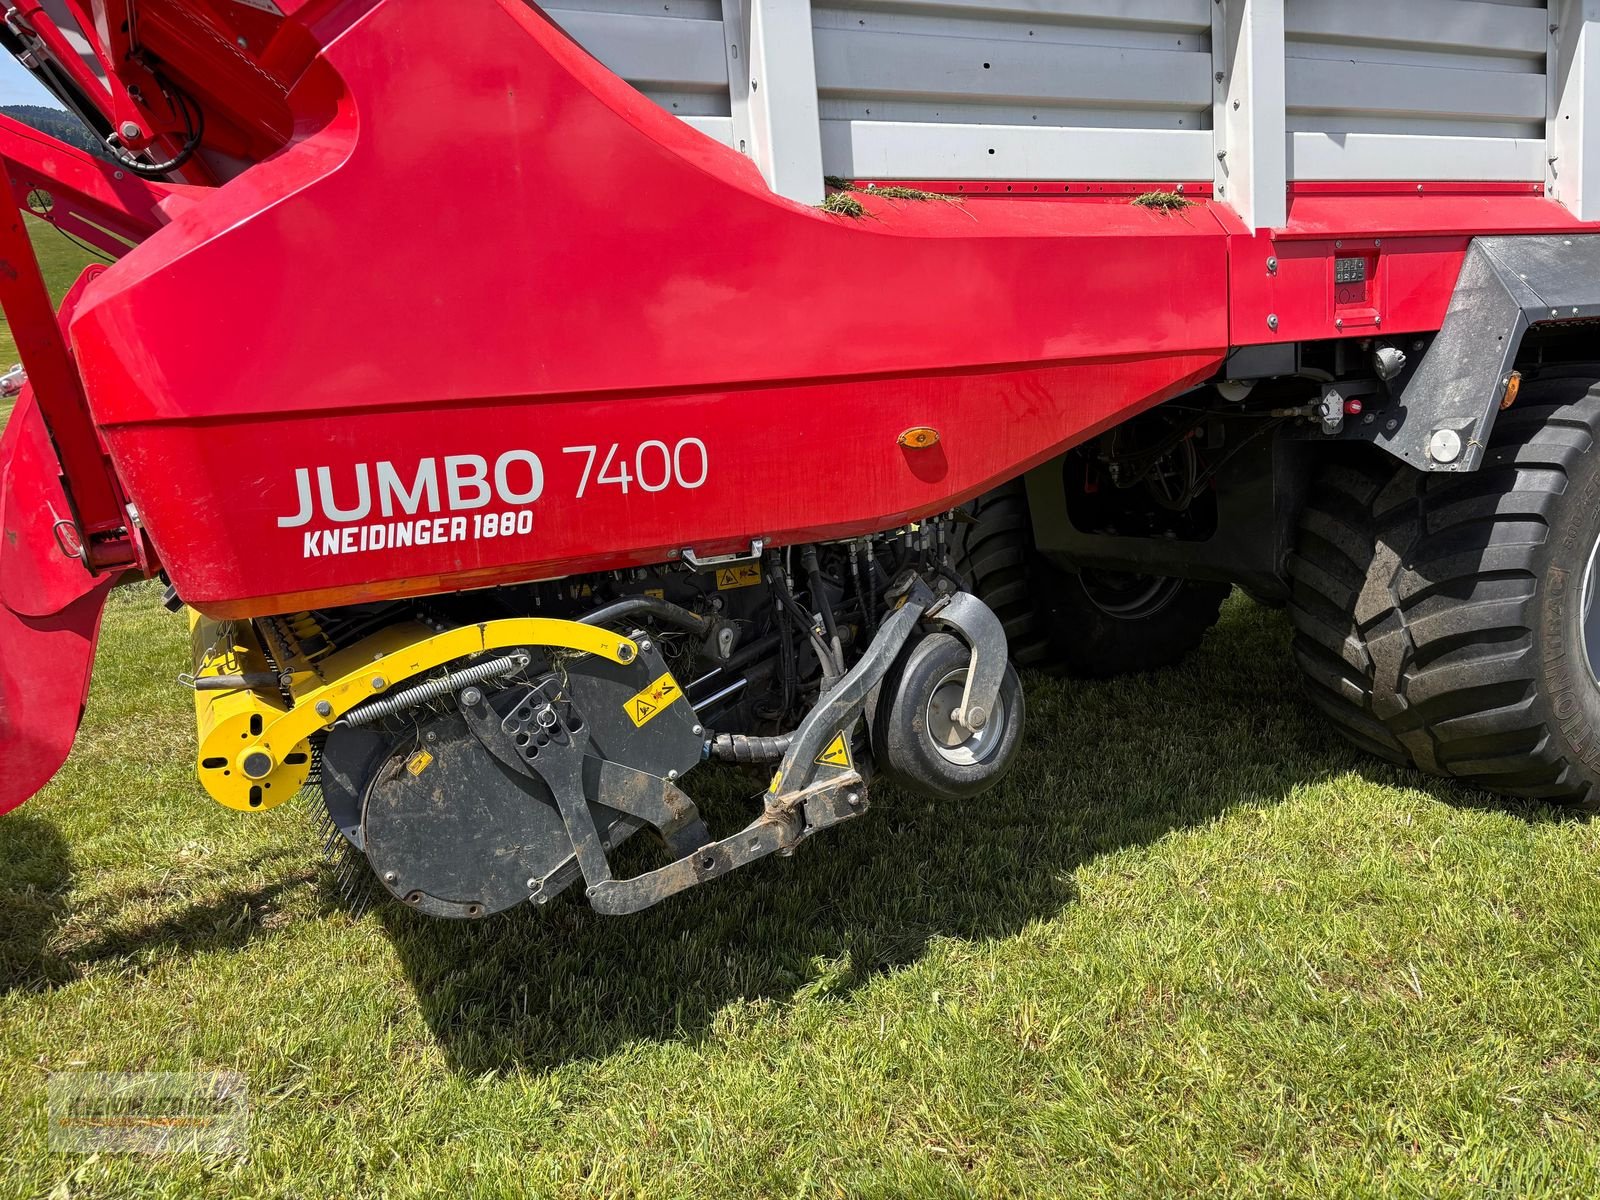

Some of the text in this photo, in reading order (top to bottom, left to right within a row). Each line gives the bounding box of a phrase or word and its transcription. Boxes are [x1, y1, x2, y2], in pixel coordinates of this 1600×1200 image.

[277, 437, 709, 528] JUMBO 7400
[303, 509, 534, 559] KNEIDINGER 1880
